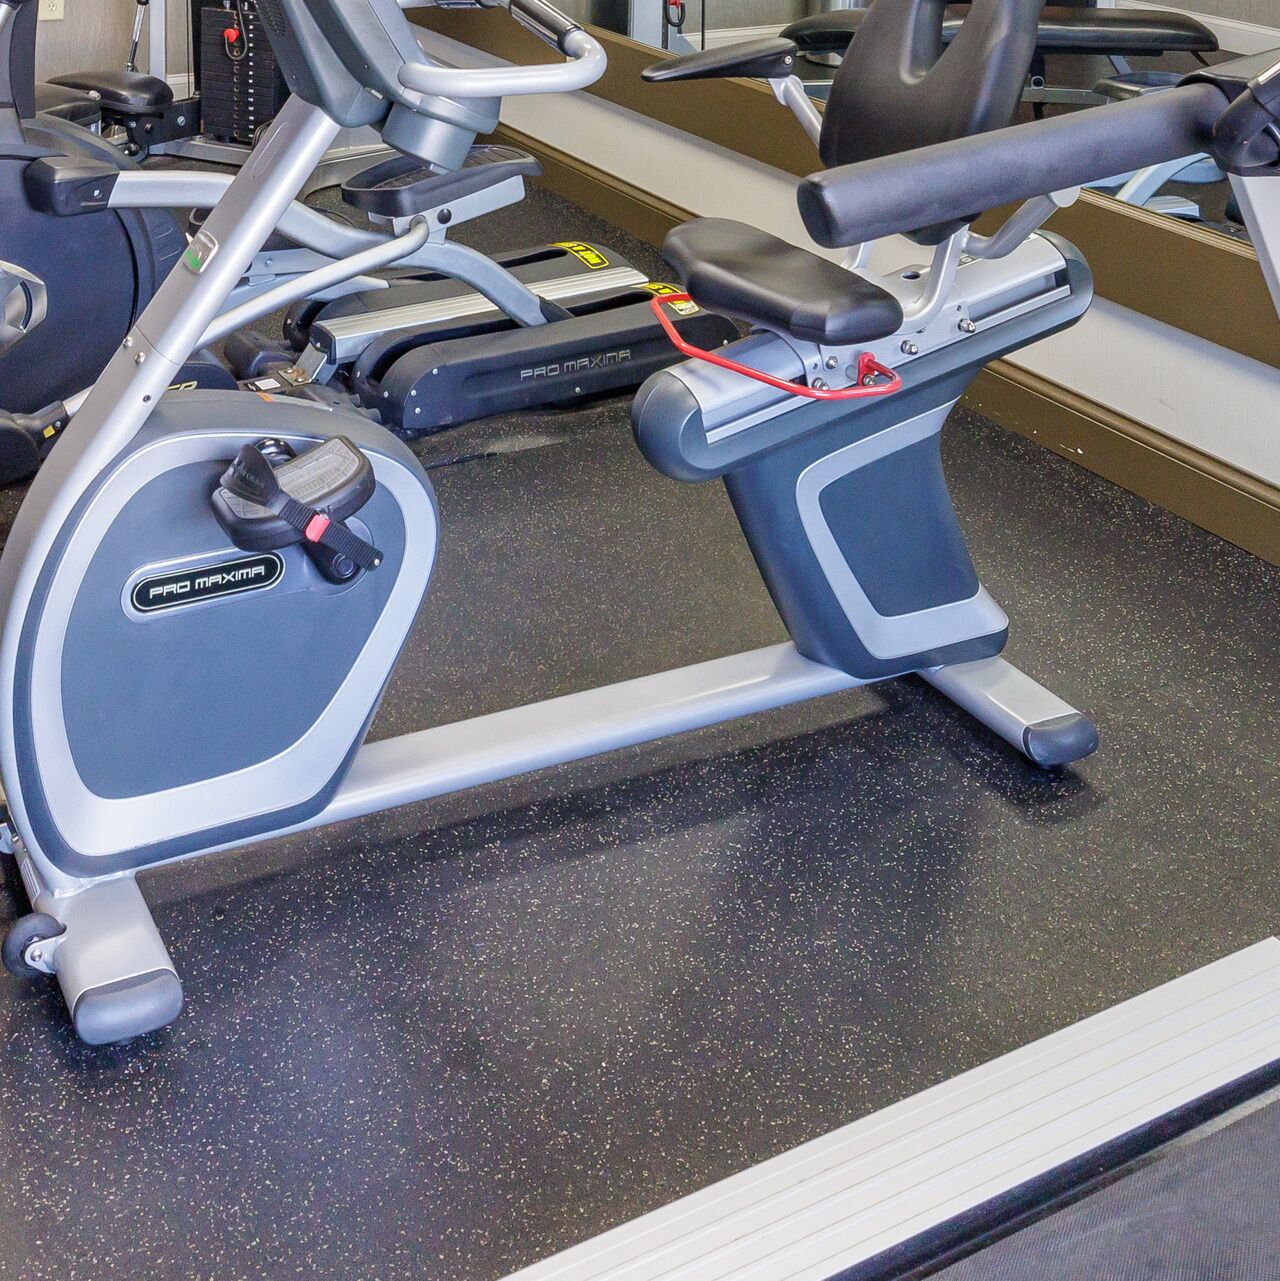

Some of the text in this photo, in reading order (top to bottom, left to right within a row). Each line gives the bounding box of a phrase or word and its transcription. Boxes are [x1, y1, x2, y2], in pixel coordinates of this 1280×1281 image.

[520, 349, 631, 381] PRO MAXIMA
[149, 565, 265, 599] PRO MAXIMA
